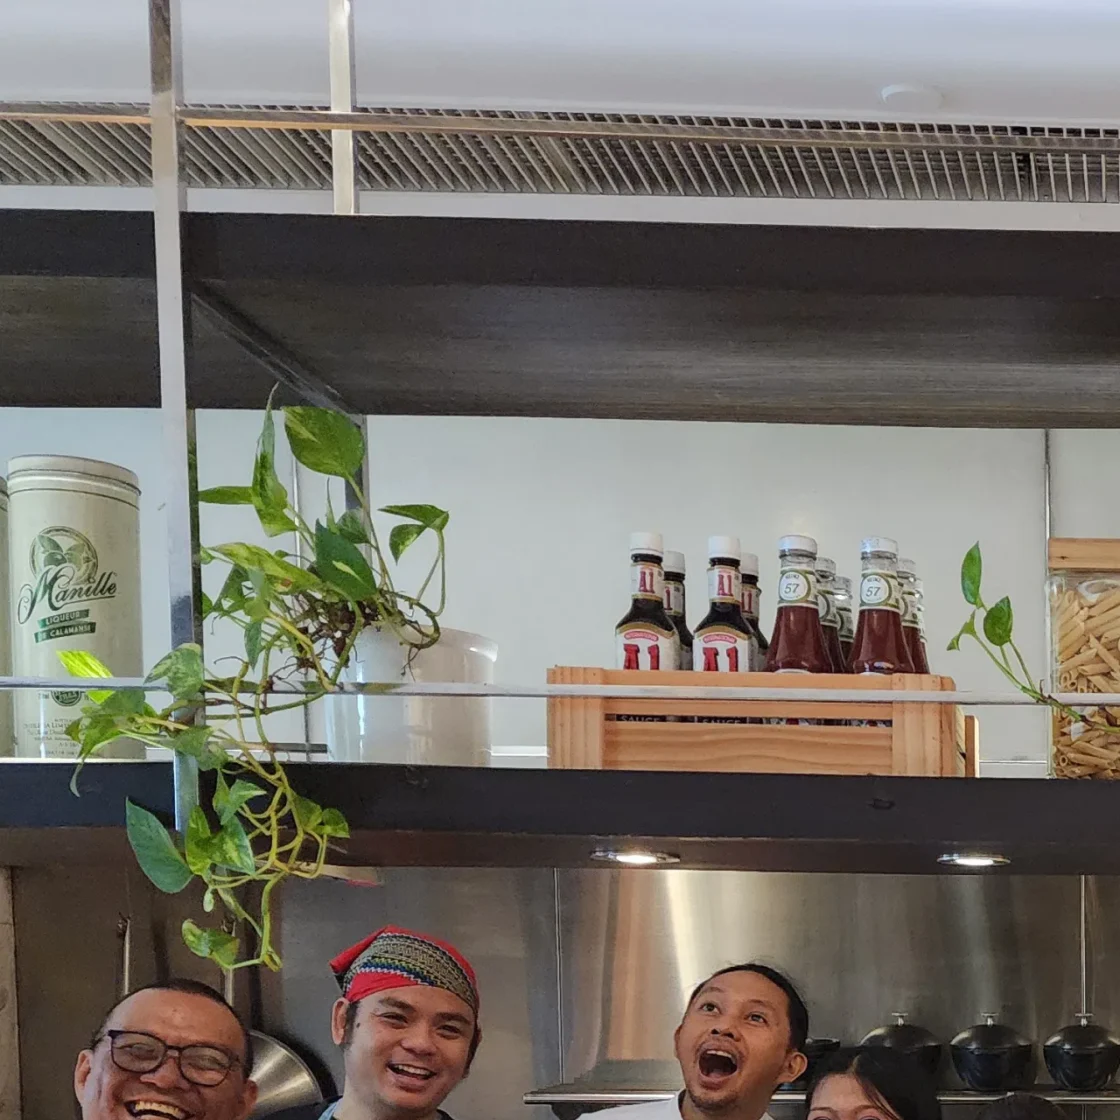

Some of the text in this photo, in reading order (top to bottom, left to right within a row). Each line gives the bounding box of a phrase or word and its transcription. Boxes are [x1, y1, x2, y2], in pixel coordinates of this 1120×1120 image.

[638, 570, 656, 594] A1
[717, 574, 734, 597] A1
[784, 583, 800, 594] 57
[18, 565, 117, 625] Manille
[865, 586, 881, 598] 57
[45, 611, 80, 626] LIQUEUR
